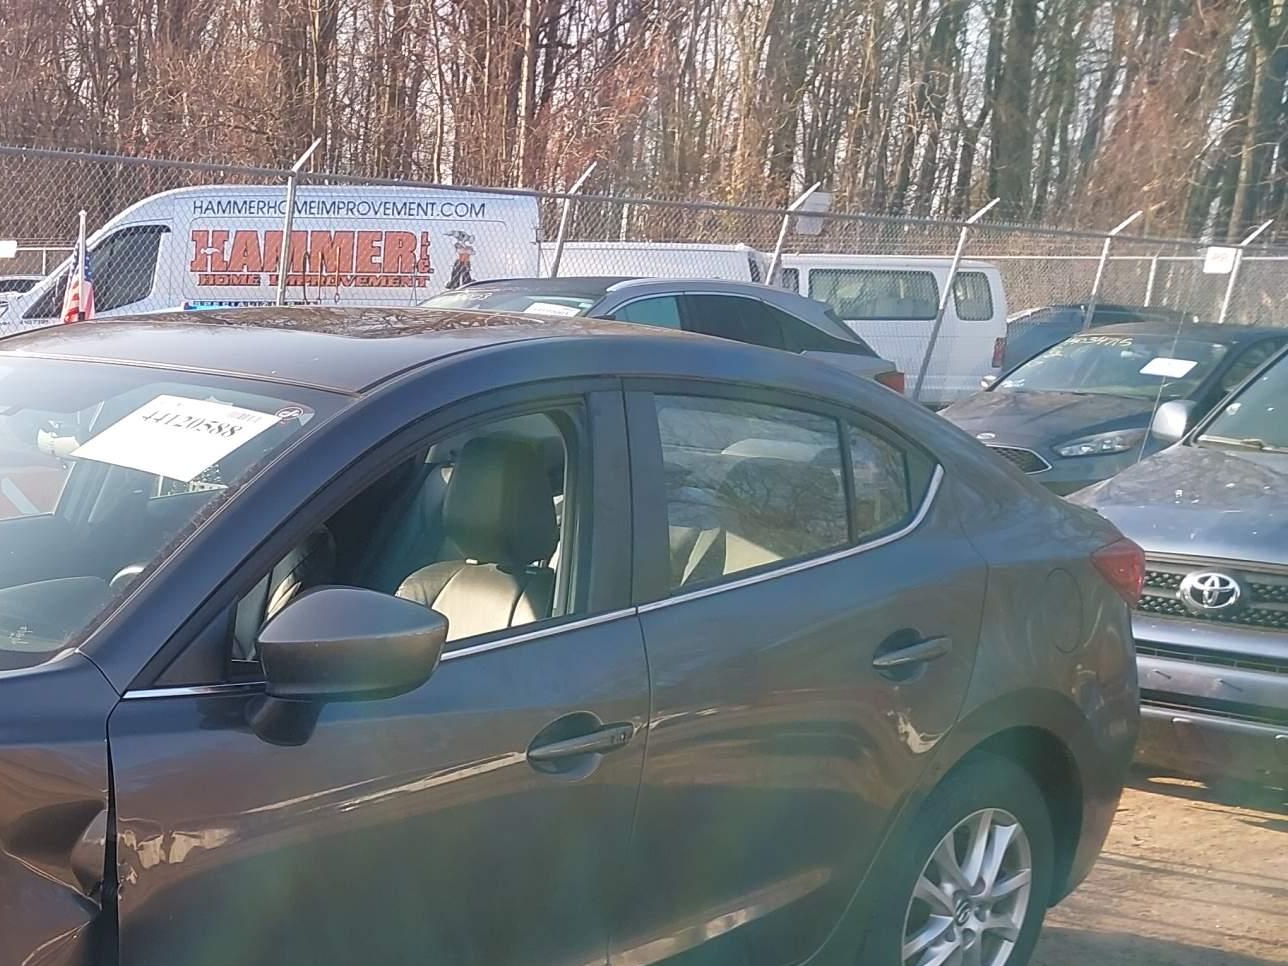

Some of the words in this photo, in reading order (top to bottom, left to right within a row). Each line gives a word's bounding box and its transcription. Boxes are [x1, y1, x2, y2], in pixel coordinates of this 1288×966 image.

[192, 200, 486, 218] HAMMERHOMEIMPROVEMENT.COM
[190, 229, 418, 273] HAMMER
[198, 273, 261, 287] HOME
[268, 273, 431, 288] IMPROVEMENT
[142, 410, 243, 437] 44120588
